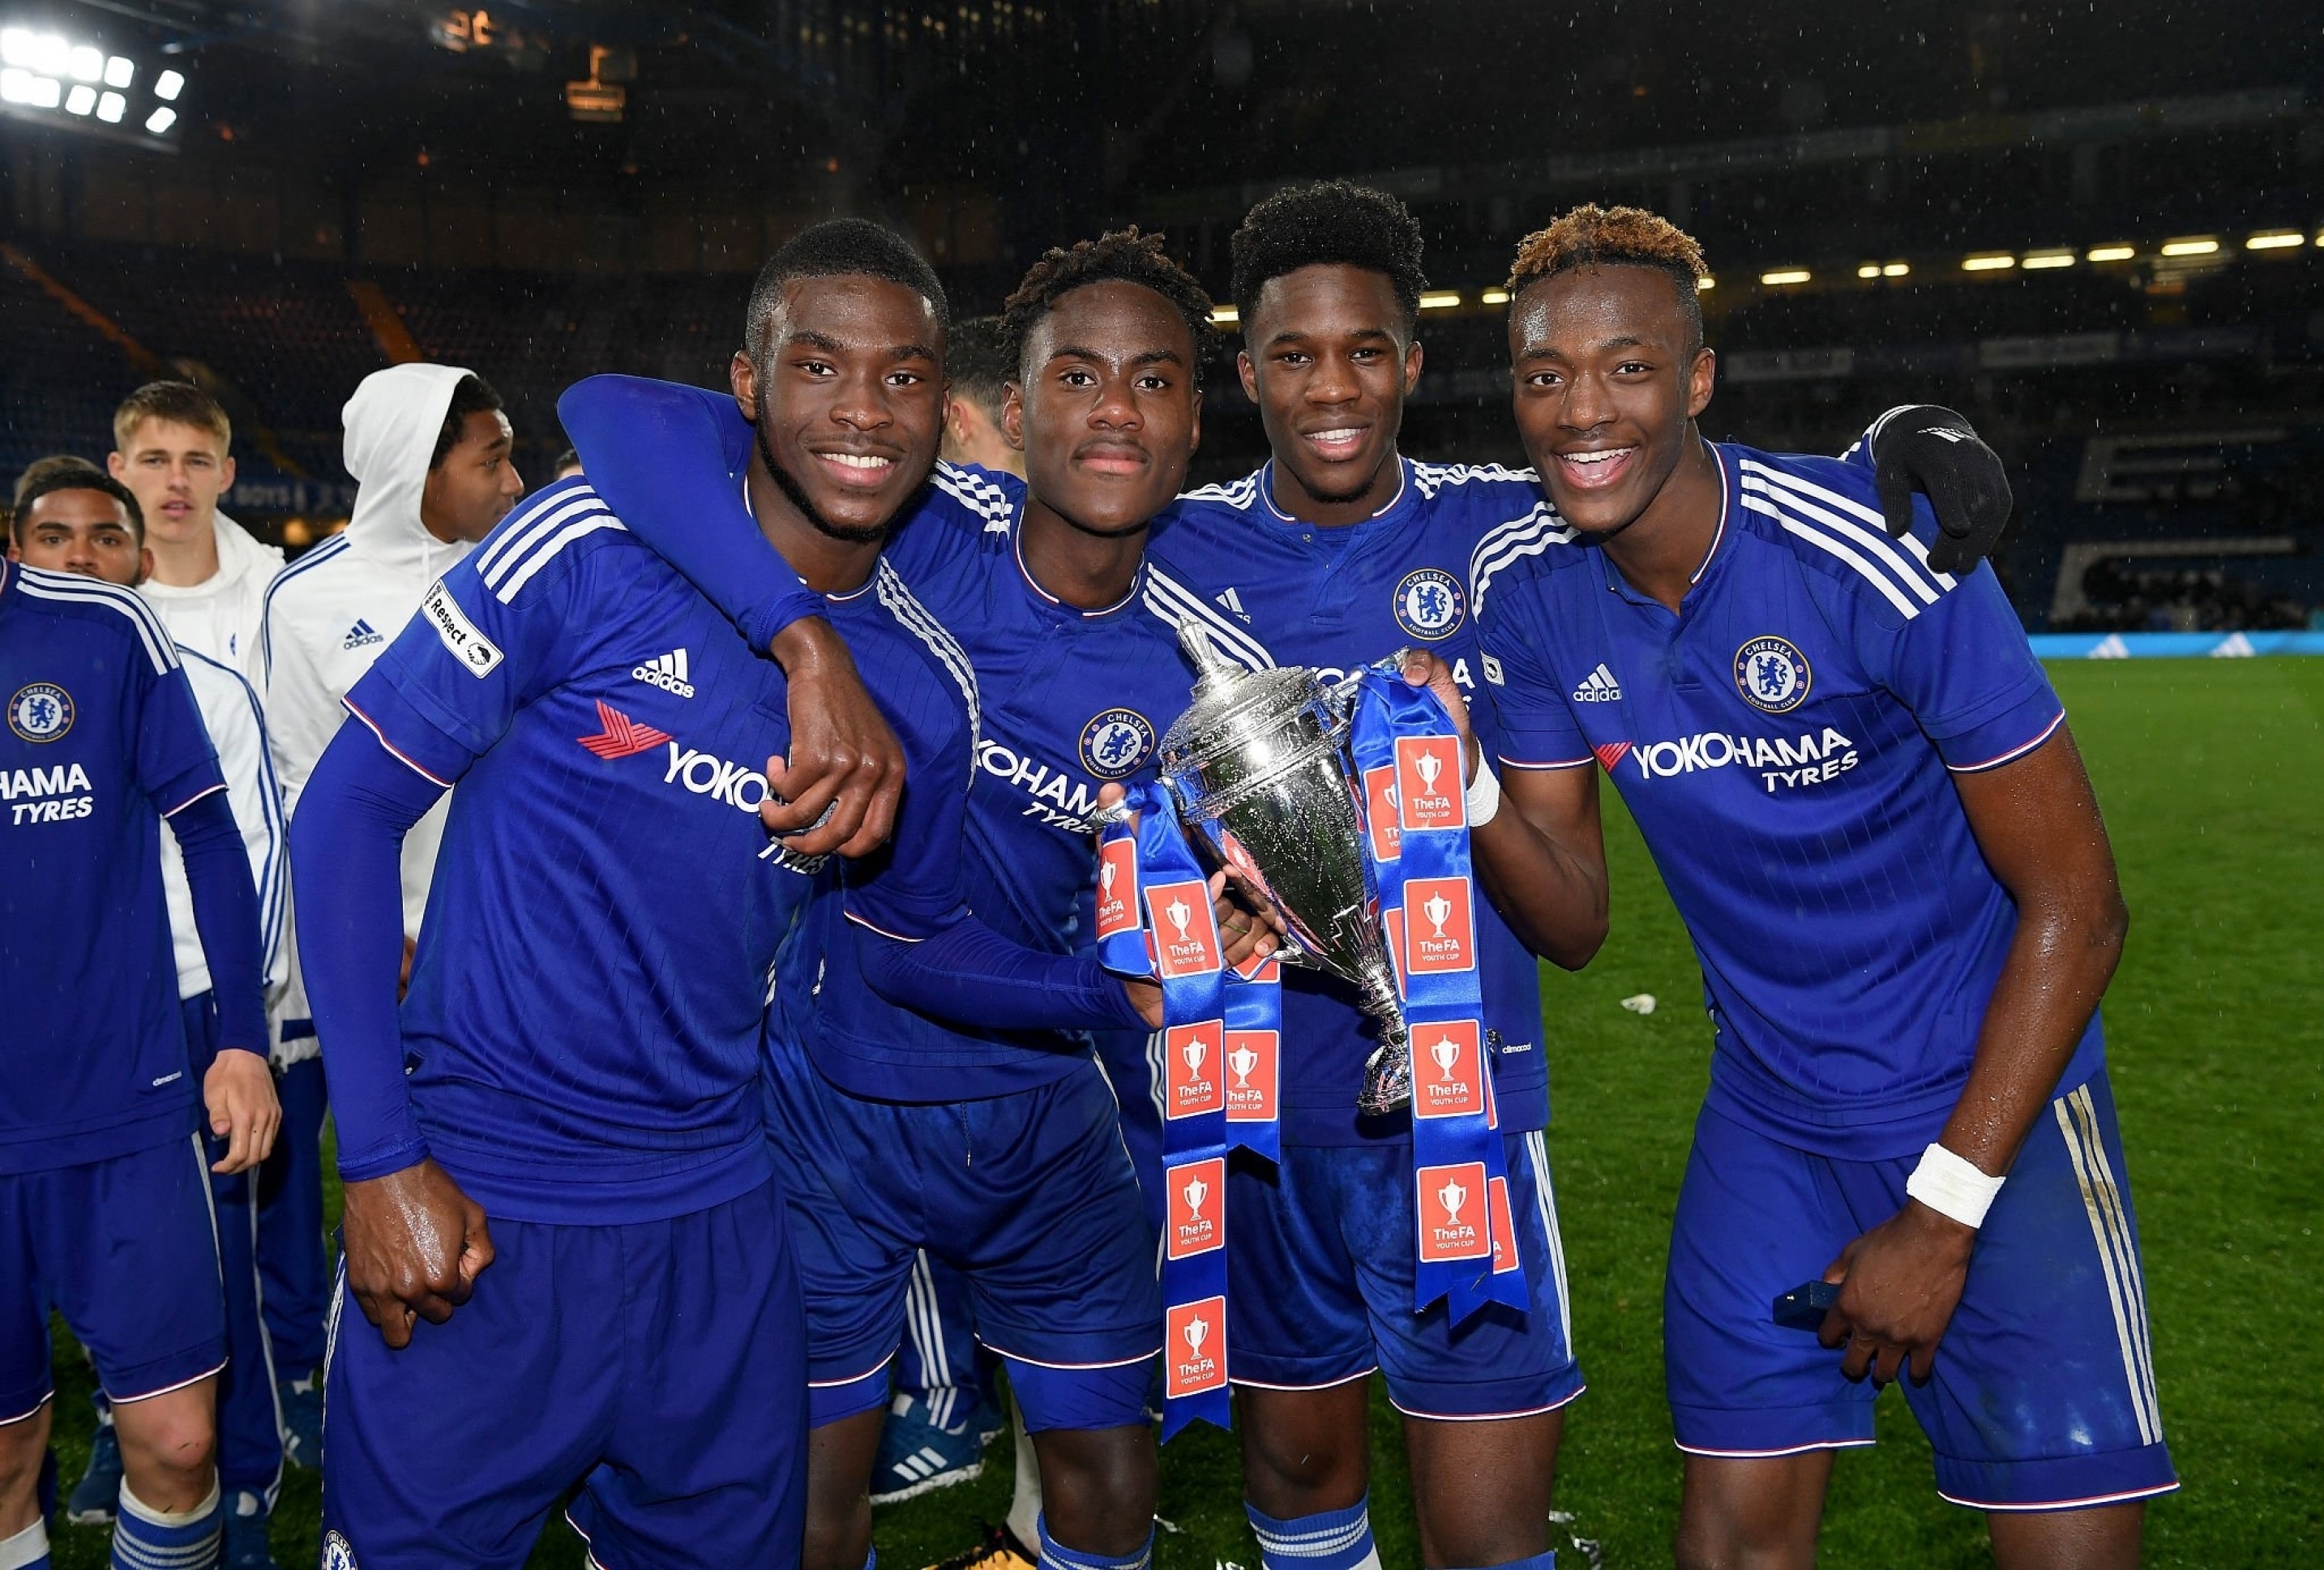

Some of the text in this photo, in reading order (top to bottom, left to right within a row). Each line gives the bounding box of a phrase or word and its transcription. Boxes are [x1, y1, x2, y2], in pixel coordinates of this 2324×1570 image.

[1406, 572, 1451, 588] CHELSEA
[430, 598, 467, 645] Respect
[1409, 622, 1456, 635] FOOTBALL CLUB
[344, 634, 384, 650] adidas
[1745, 641, 1792, 658] CHELSEA
[631, 666, 695, 698] adidas
[20, 687, 62, 699] CHELSEA
[1107, 713, 1149, 738] CHELSEA
[1631, 727, 1853, 780] YOKOHAMA
[664, 741, 774, 814] YOKO
[976, 739, 1098, 815] OHAM
[1761, 751, 1859, 793] TYRES
[11, 796, 93, 825] TYRES
[1022, 801, 1095, 834] TYRE
[1200, 1095, 1212, 1103] CUP
[1454, 1096, 1468, 1104] CUP
[1200, 1233, 1213, 1241] CUP
[1202, 1371, 1215, 1380] CUP
